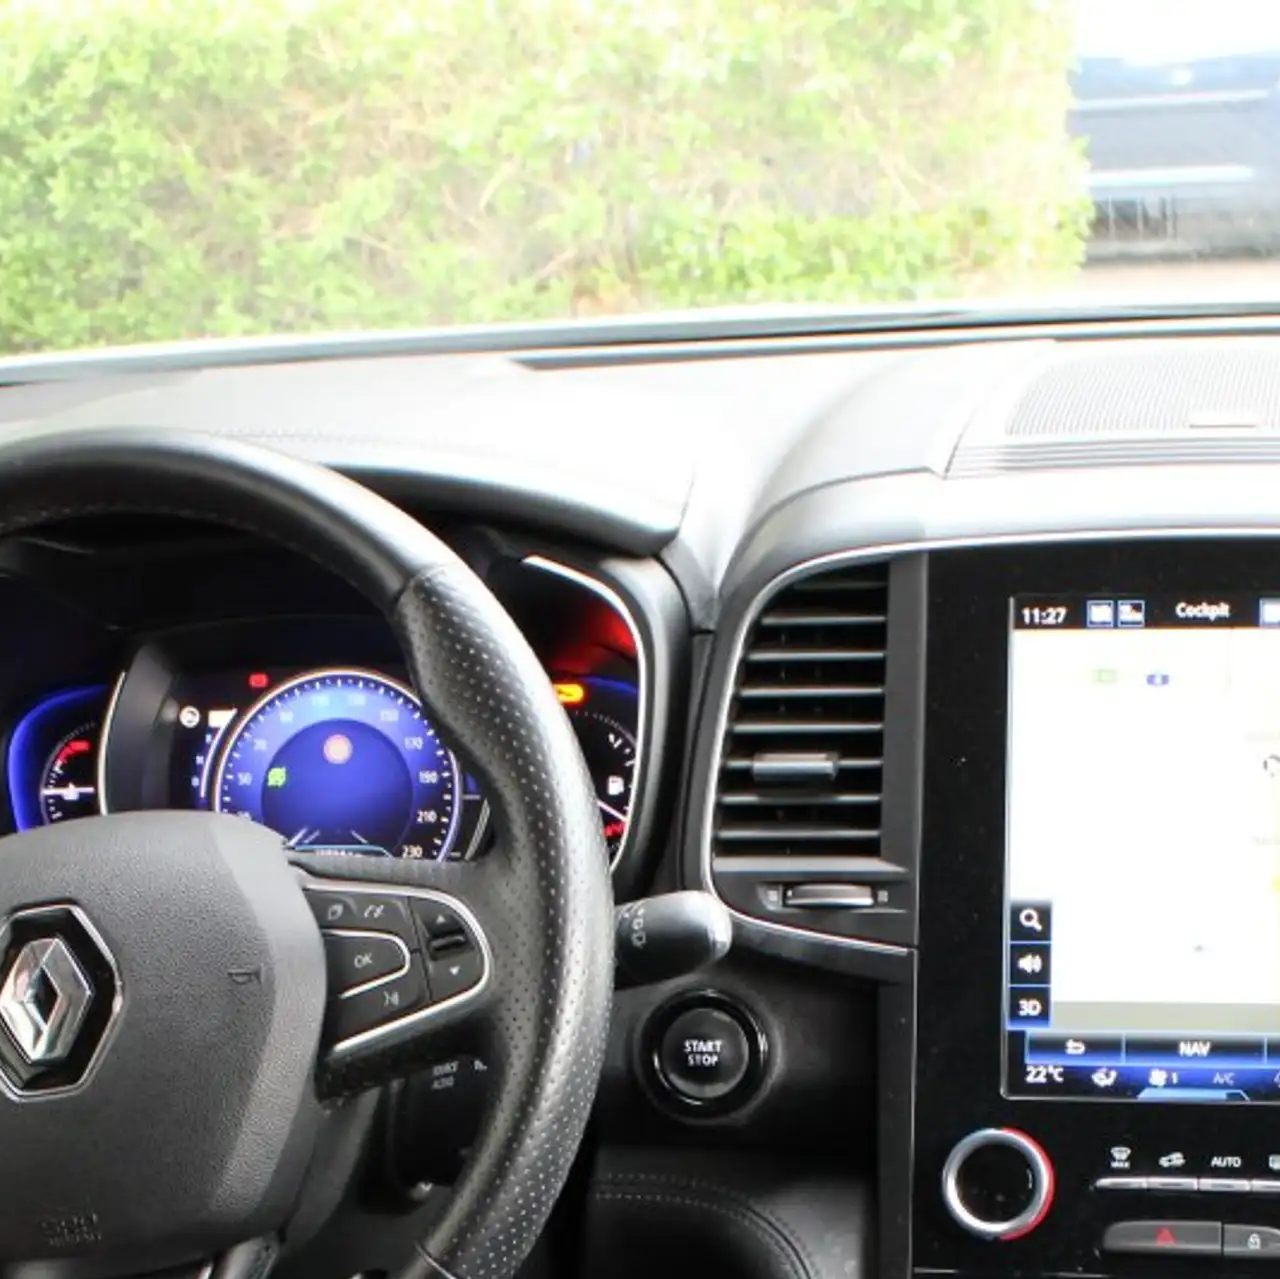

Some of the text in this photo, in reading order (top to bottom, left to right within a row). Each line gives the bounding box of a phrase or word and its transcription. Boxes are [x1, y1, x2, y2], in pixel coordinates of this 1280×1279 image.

[1022, 606, 1068, 624] 11:27
[1175, 602, 1230, 620] Cockpit
[354, 952, 373, 969] OK
[1018, 999, 1042, 1016] 3D
[684, 1040, 722, 1052] START
[1179, 1041, 1211, 1057] NAV
[688, 1054, 718, 1066] STOP
[1025, 1065, 1064, 1083] 22°C
[1213, 1072, 1235, 1085] A/C
[1211, 1156, 1242, 1168] AUTO
